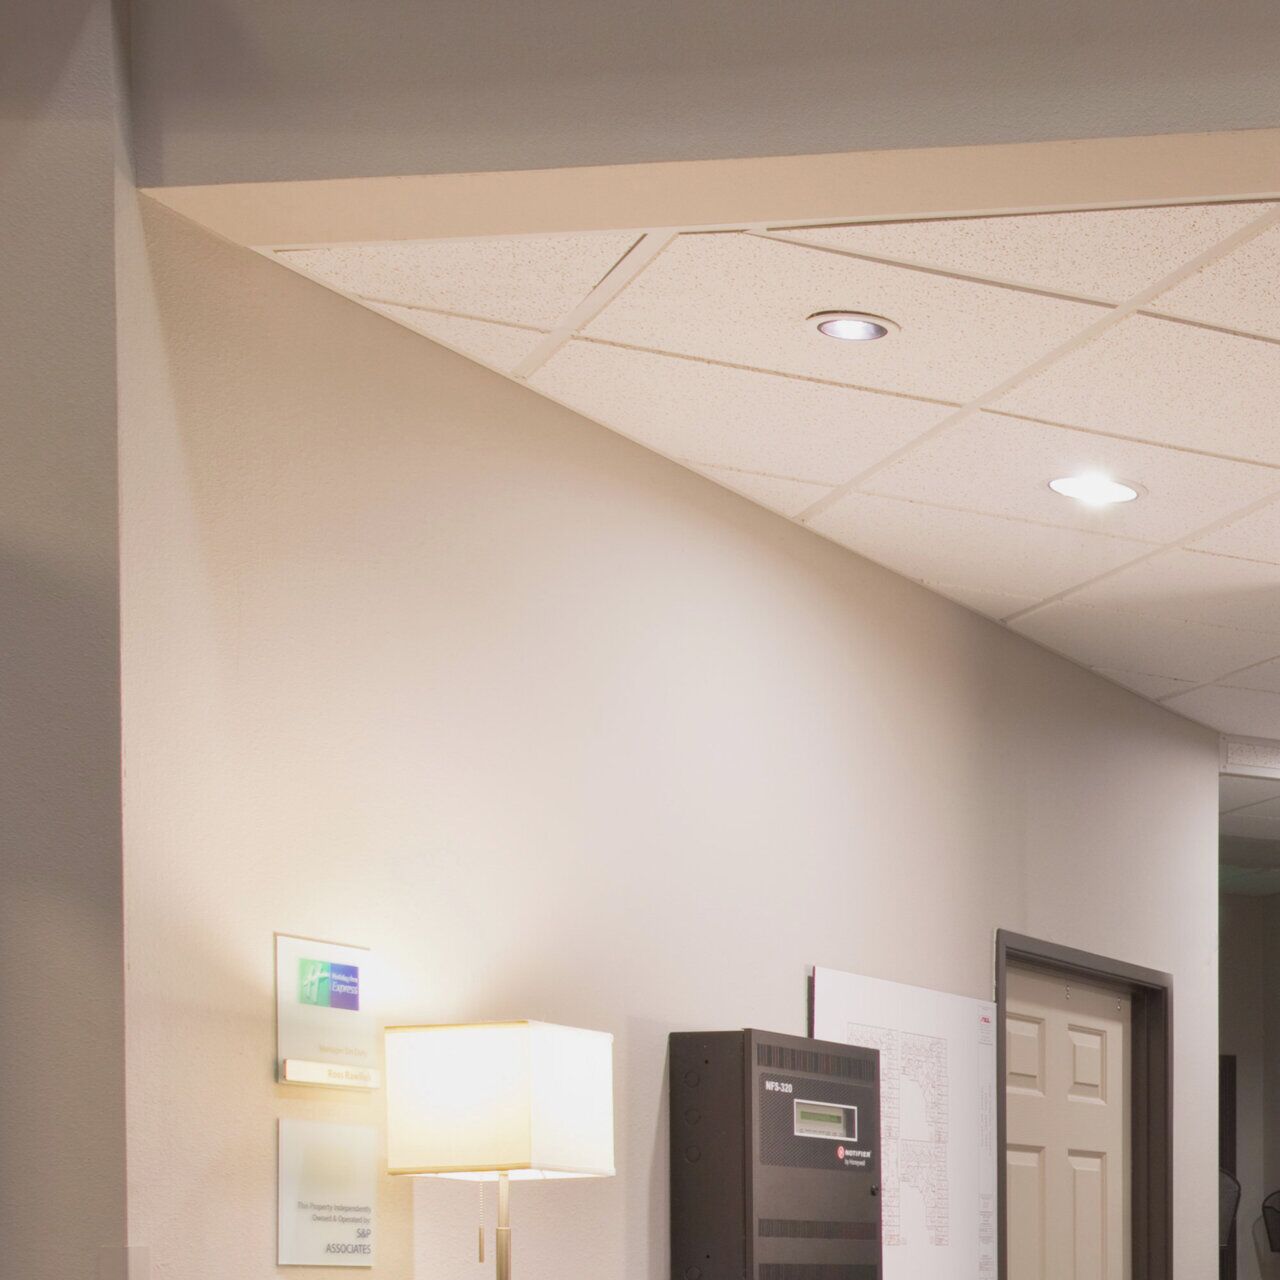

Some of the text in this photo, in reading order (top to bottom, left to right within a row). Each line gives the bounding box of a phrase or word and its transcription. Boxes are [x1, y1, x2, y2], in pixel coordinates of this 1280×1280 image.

[331, 982, 359, 995] Express
[765, 1080, 793, 1093] NFS-320
[845, 1149, 871, 1159] NOTIFIER
[310, 1202, 333, 1213] Property
[312, 1214, 331, 1223] Owned
[338, 1215, 362, 1225] Operated
[356, 1228, 372, 1239] S&P
[326, 1243, 372, 1255] ASSOCIATES
